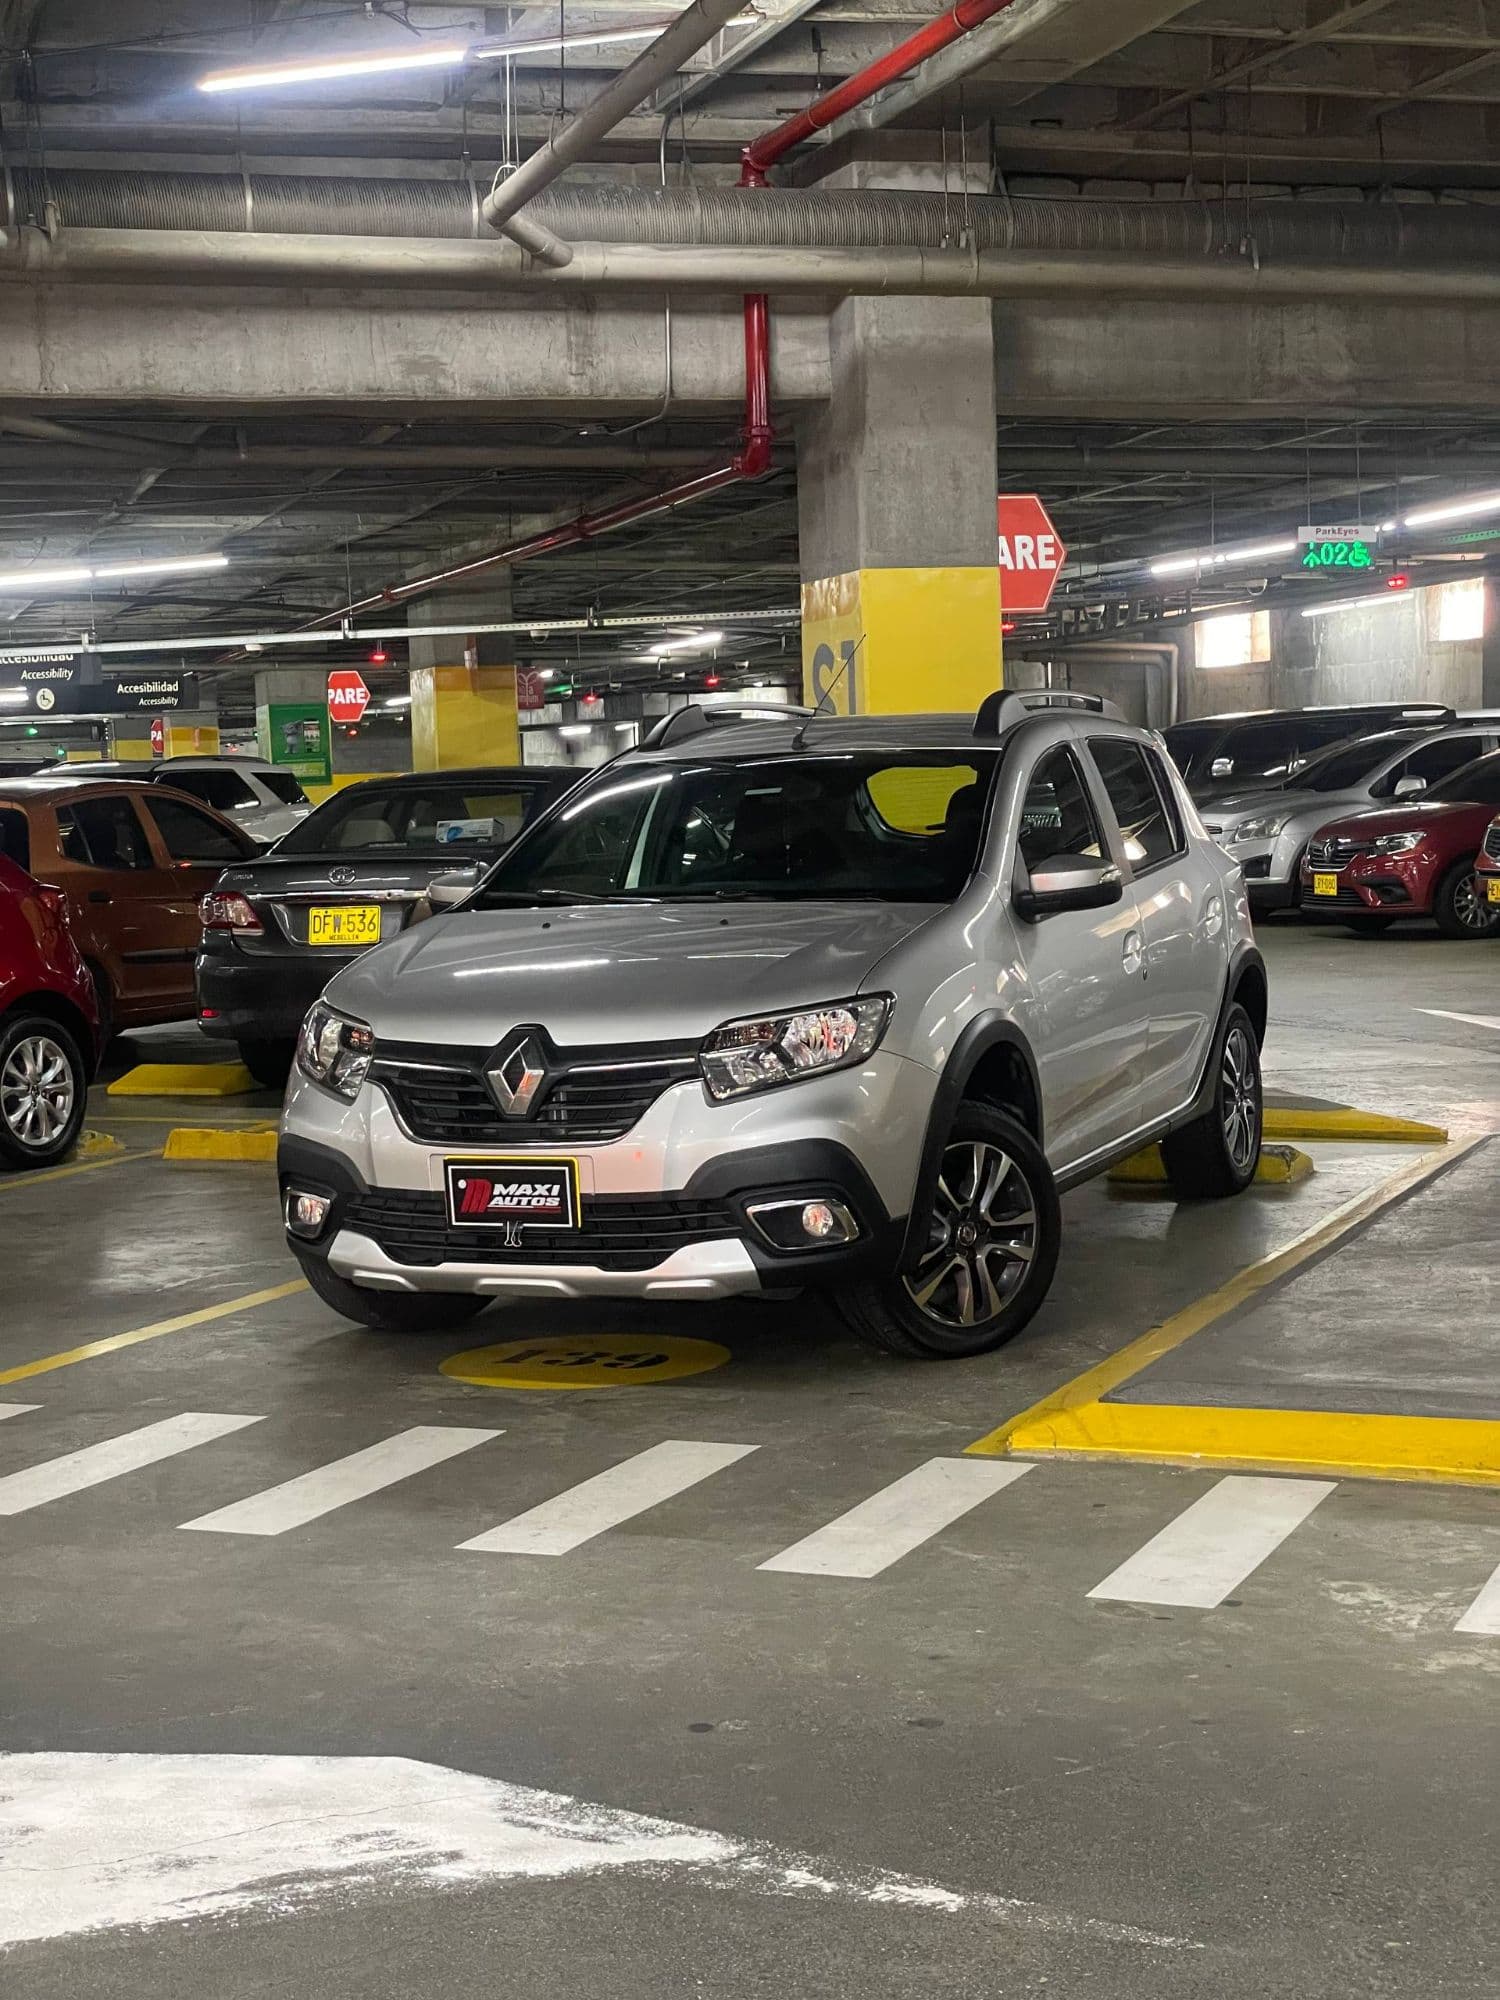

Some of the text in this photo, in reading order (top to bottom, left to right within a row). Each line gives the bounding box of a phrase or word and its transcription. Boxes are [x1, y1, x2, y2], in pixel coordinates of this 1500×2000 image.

[1315, 527, 1359, 536] ParkEyes
[998, 534, 1056, 570] ARE
[0, 654, 74, 664] ccesibilidad
[20, 667, 74, 680] Accessibility
[117, 681, 179, 694] Accesibilidad
[138, 697, 178, 706] Accessibility
[327, 688, 366, 704] PARE
[151, 730, 163, 741] PA
[493, 1183, 560, 1196] MAXI
[489, 1196, 560, 1207] AUTOS
